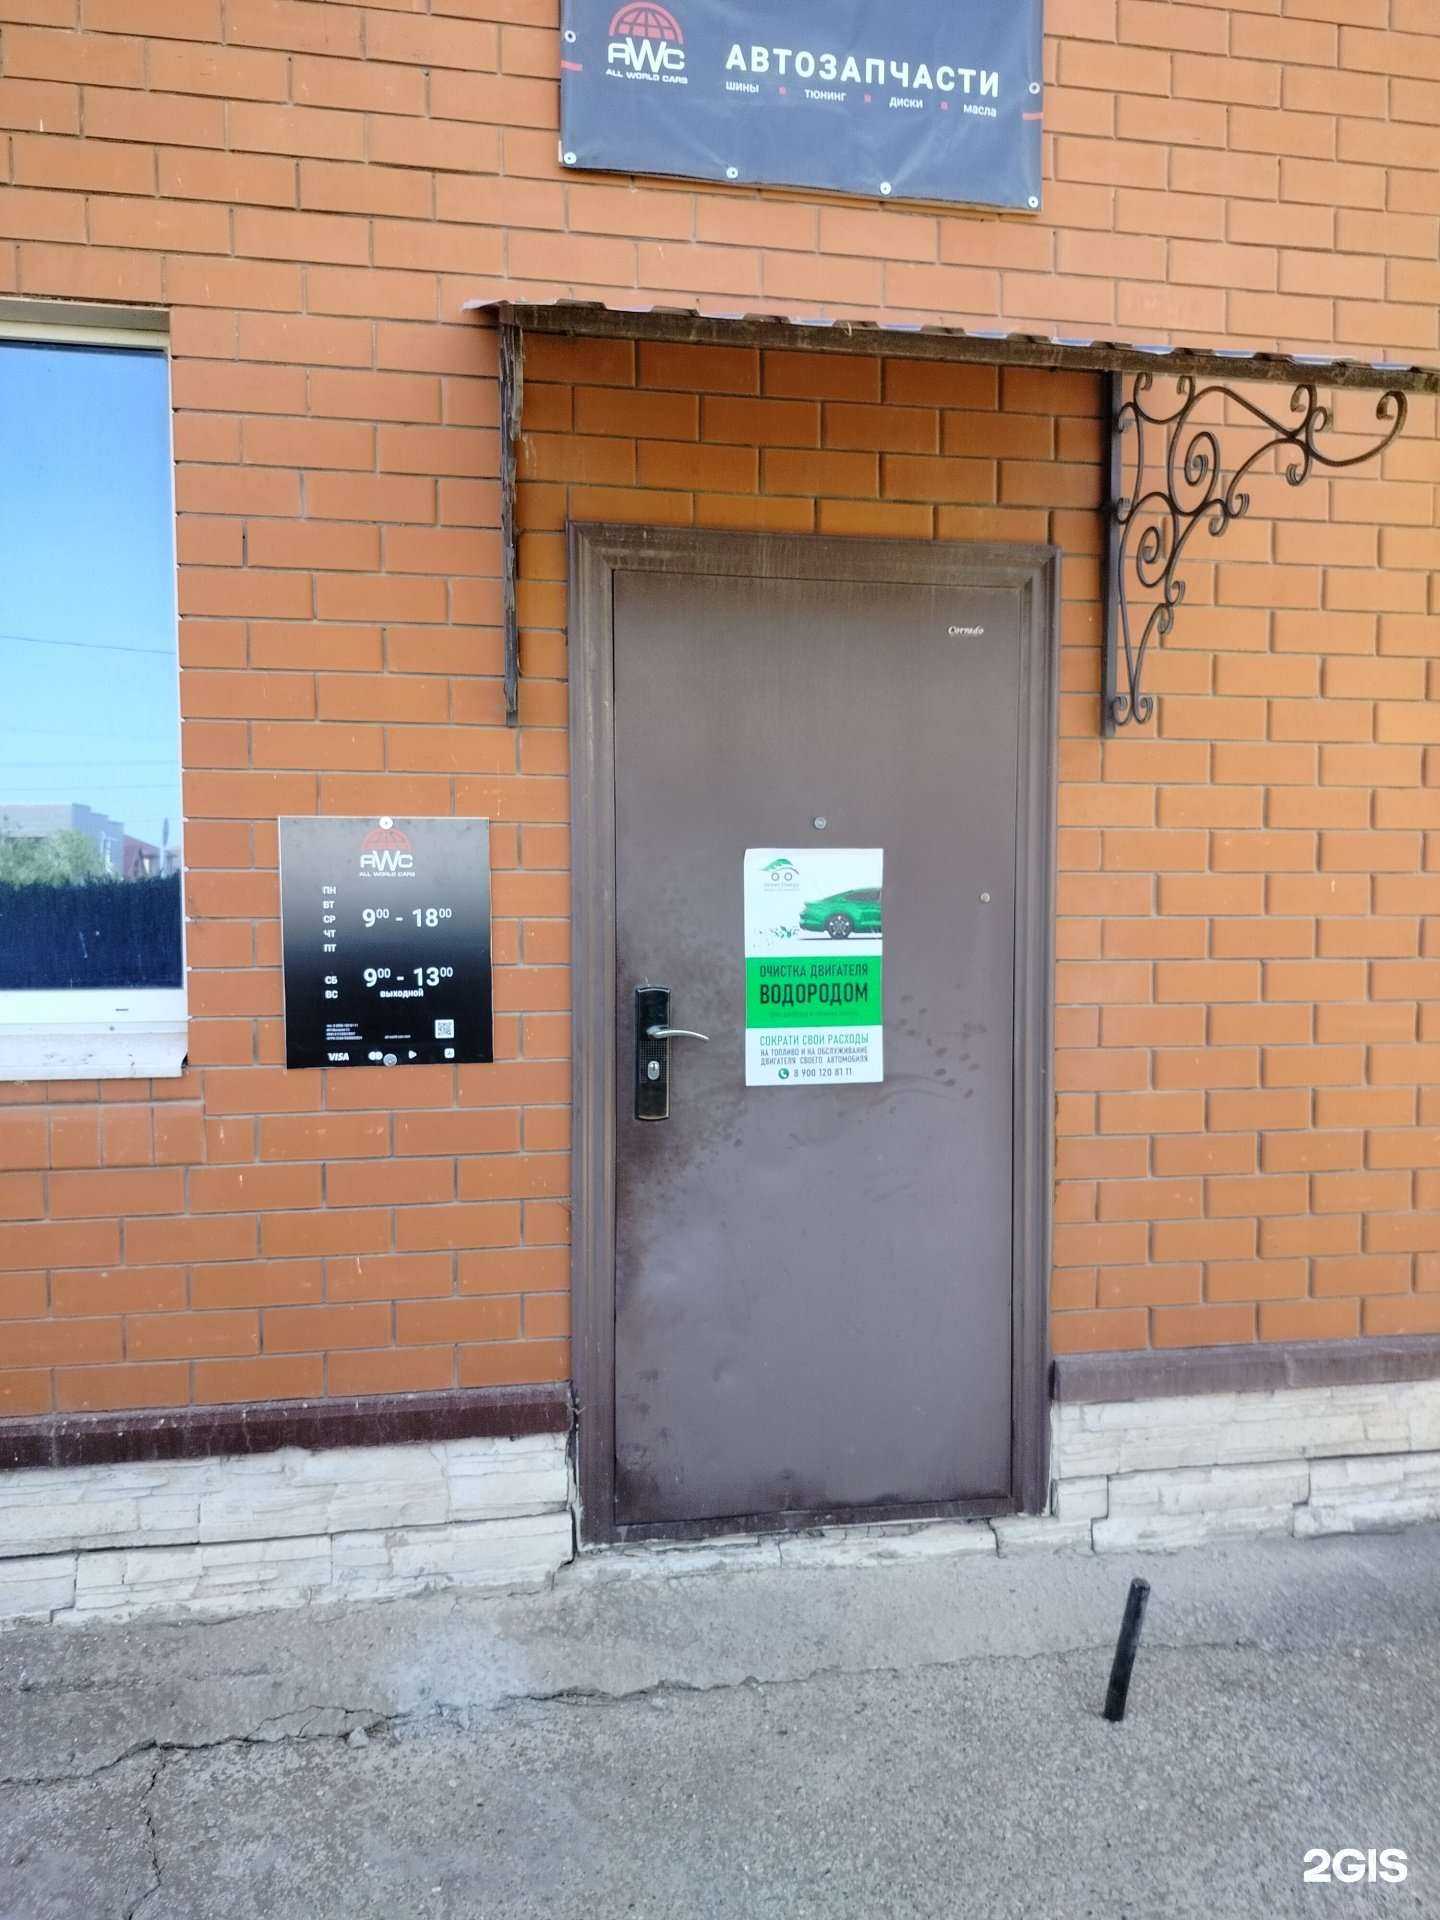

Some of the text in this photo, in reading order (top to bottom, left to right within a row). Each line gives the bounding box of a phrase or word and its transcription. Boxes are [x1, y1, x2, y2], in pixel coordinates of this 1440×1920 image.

[725, 43, 1000, 97] АВТОЗАПЧАСТИ
[605, 68, 688, 84] ALL WORLD CARS
[963, 103, 997, 118] масла
[323, 886, 336, 895] ПН
[323, 901, 335, 909] ВТ
[323, 915, 336, 924] СР
[323, 929, 336, 938] ЧТ
[324, 944, 336, 952] ПТ
[759, 963, 868, 979] ОЧИСТКА ДВИГАТЕЛЯ
[325, 976, 337, 984] СБ
[325, 990, 338, 999] ВС
[760, 982, 868, 1007] ВОДОРОДОМ
[760, 1033, 869, 1046] СОКРАТИ СВОИ РАСХОДЫ
[771, 1048, 799, 1056] ТОПЛИВО
[818, 1046, 868, 1055] ОБСЛУЖИВАНИЕ
[328, 1052, 349, 1061] VISA
[761, 1055, 868, 1066] ДВИГАТЕЛЯ СВОЕГО АВТОМОБИЛЯ
[802, 1069, 815, 1077] 900
[819, 1068, 831, 1076] 120
